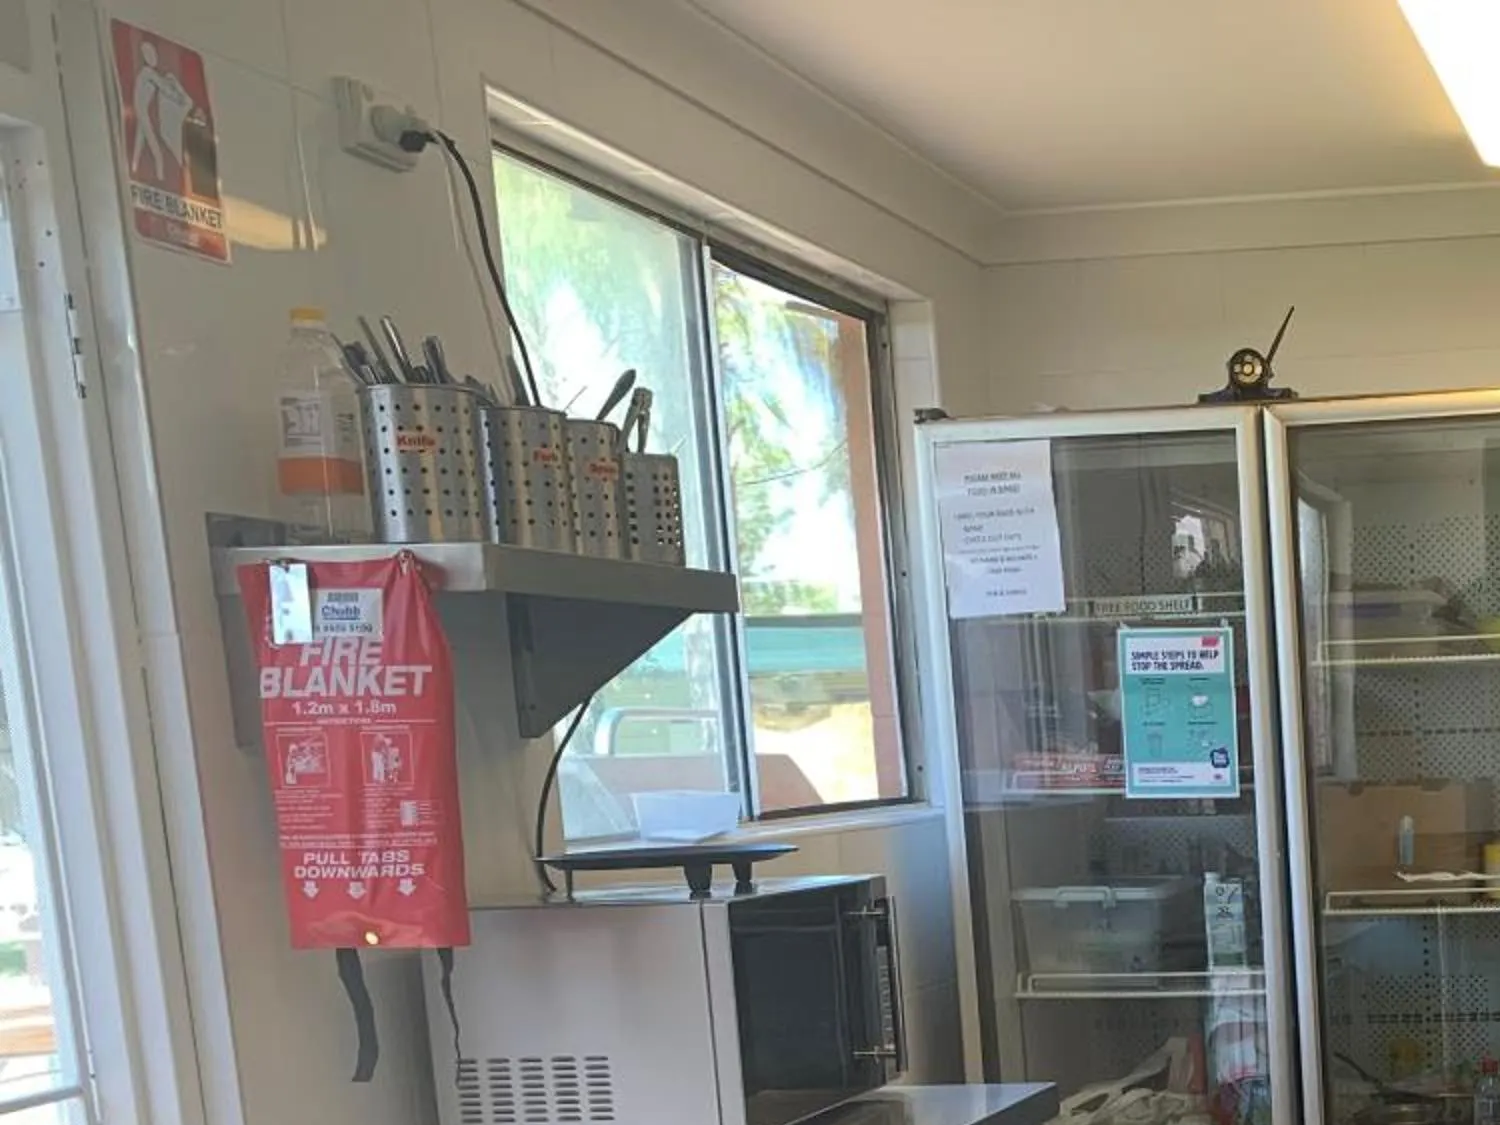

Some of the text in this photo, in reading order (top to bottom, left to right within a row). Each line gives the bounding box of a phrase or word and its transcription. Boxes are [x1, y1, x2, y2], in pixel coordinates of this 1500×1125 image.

[130, 184, 223, 229] FIRE BLANKET
[396, 435, 435, 447] Knife
[300, 636, 383, 667] FIRE
[1131, 650, 1220, 661] SIMPLE STEPS TO HELP
[1131, 661, 1152, 671] STOP
[1154, 661, 1168, 671] THE
[260, 664, 433, 698] BLANKET
[291, 702, 334, 715] 1.2m
[339, 704, 350, 714] x
[303, 850, 411, 866] PULL TABS
[294, 863, 426, 880] DOWNWARDS
